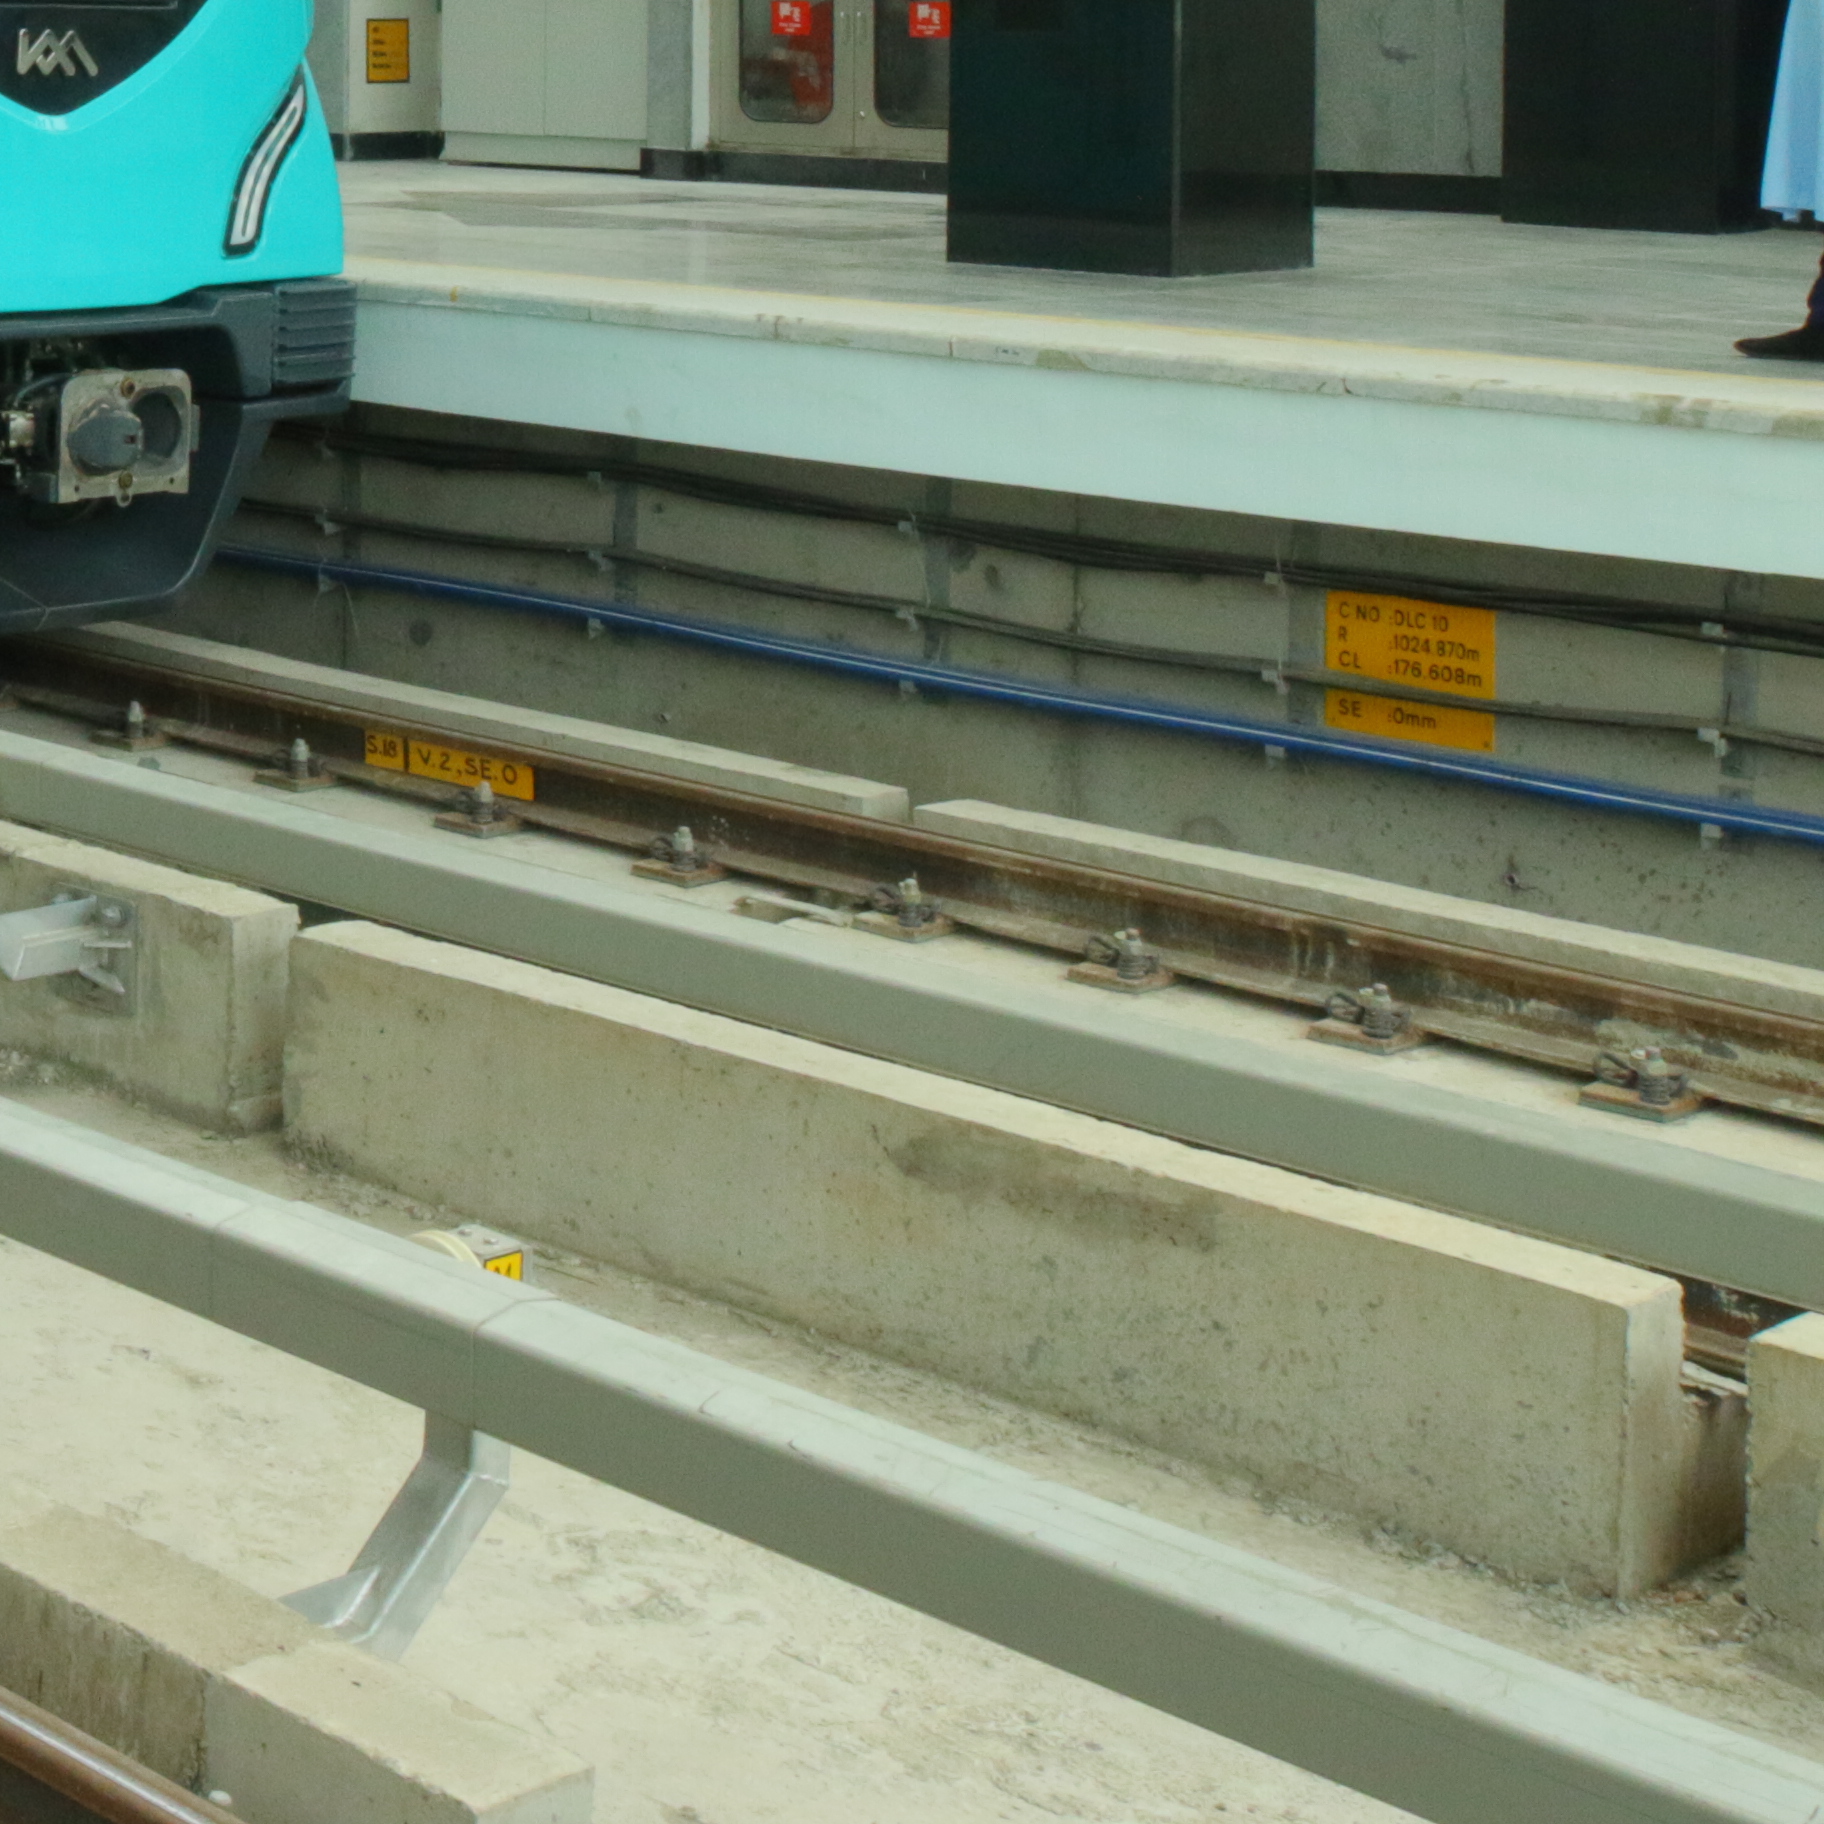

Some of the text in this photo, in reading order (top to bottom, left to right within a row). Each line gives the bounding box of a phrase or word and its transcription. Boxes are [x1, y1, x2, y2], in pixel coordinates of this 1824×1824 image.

[1433, 614, 1449, 632] 10
[1338, 625, 1348, 642] R
[1338, 650, 1361, 669] CL
[1338, 698, 1362, 718] SE
